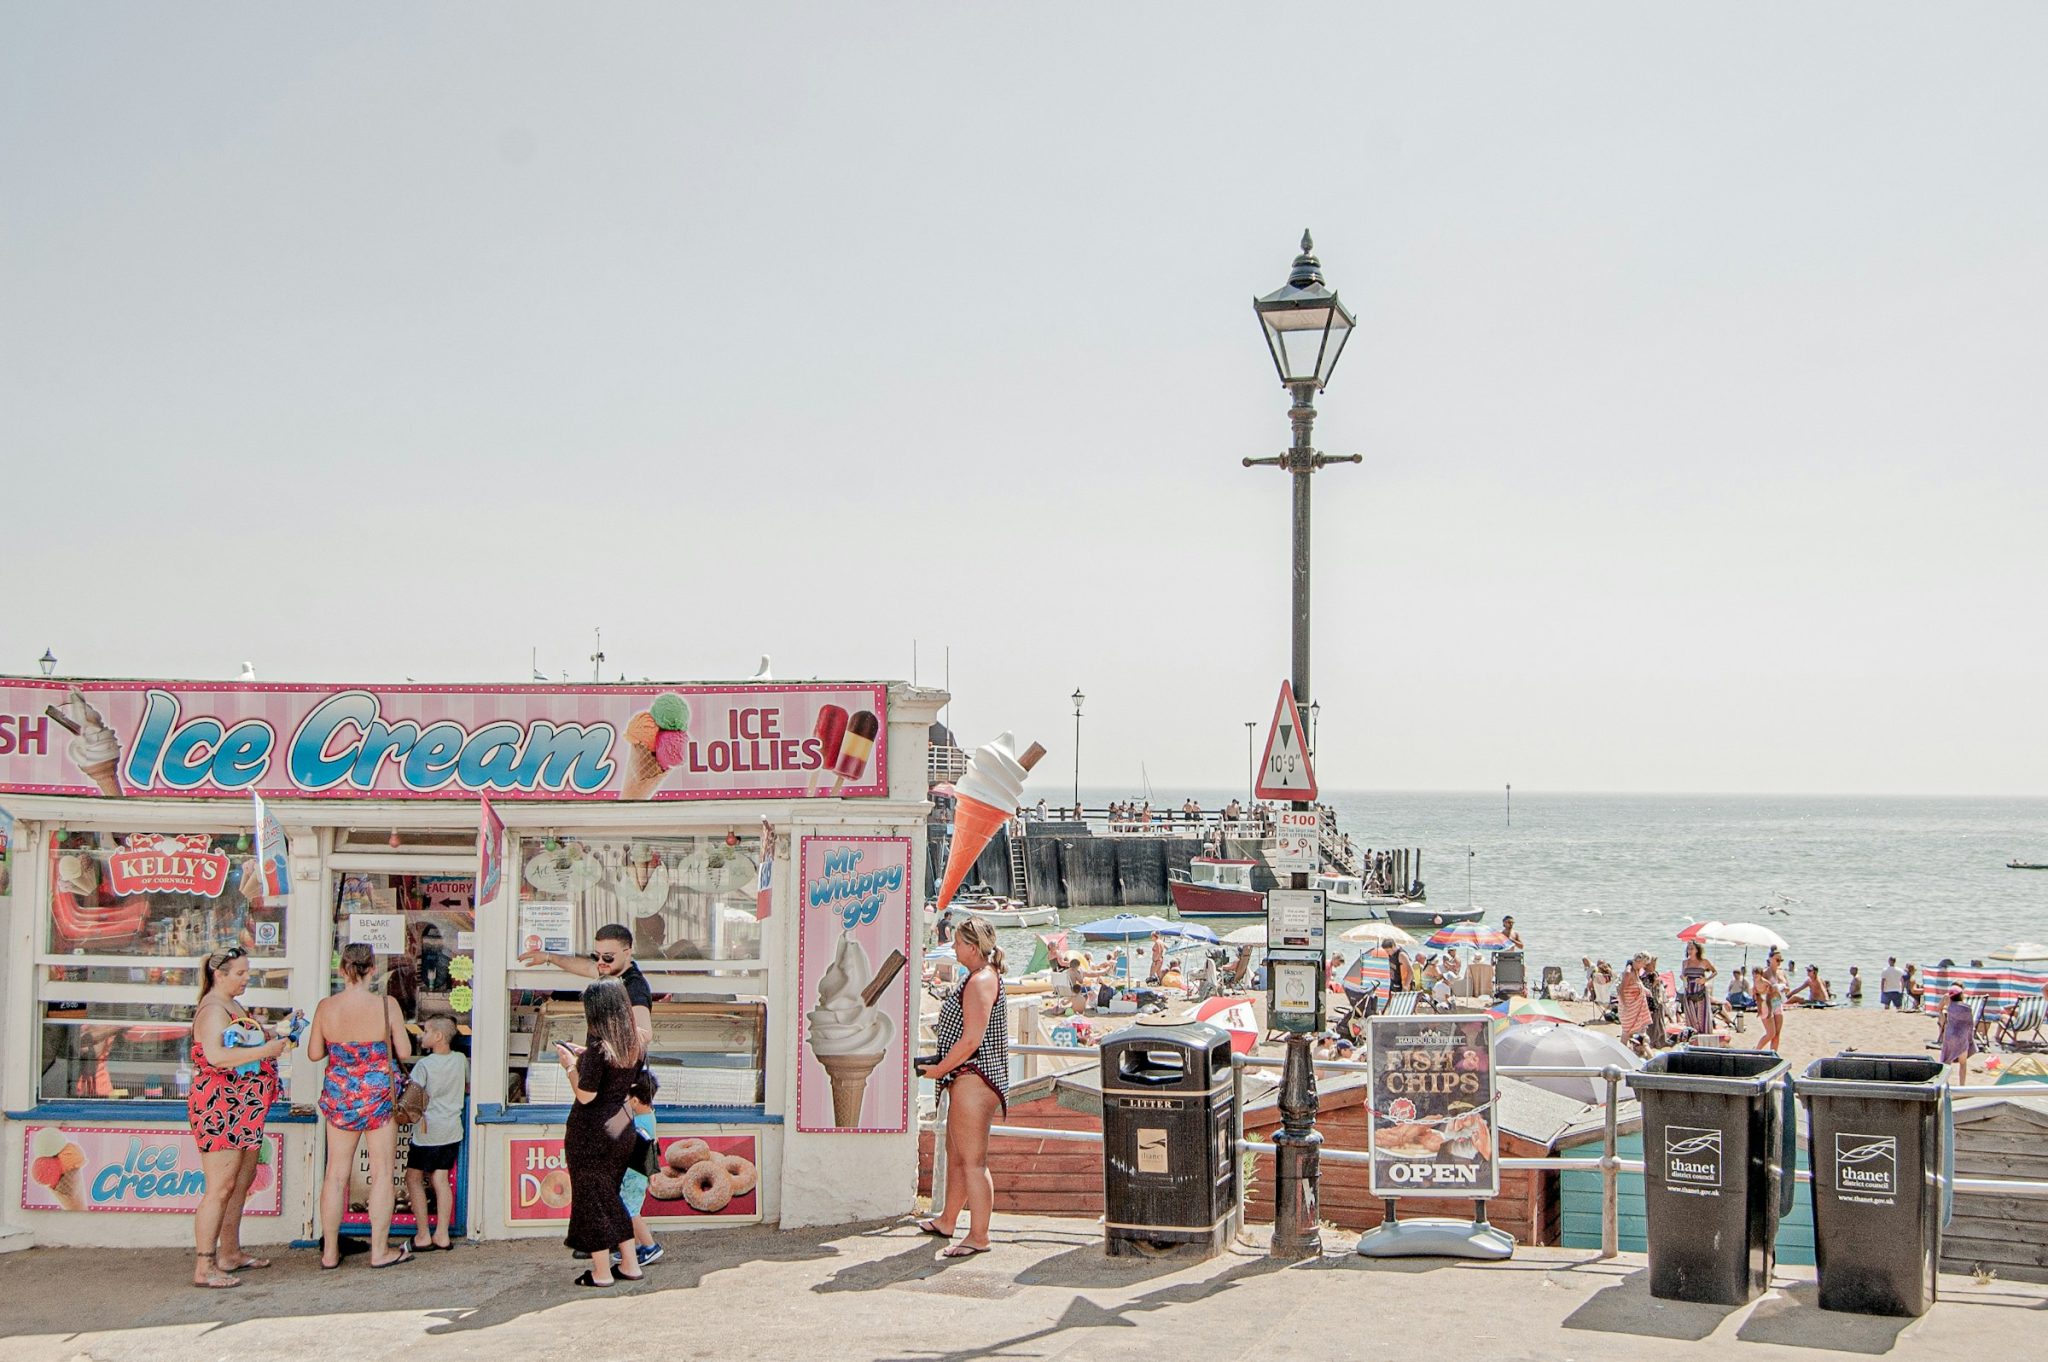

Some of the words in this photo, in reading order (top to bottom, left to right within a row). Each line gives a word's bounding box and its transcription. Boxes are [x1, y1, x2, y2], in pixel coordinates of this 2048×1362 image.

[729, 708, 781, 740] ICE
[124, 689, 277, 791] Ice
[286, 689, 617, 793] Cream
[689, 738, 822, 772] LOLLIES
[1282, 814, 1316, 826] £100
[120, 856, 218, 880] KELLY'S
[824, 846, 864, 879] Mr
[426, 883, 473, 894] FACTORY
[809, 864, 904, 908] Whippy
[360, 919, 391, 927] BEWARE
[1385, 1050, 1455, 1071] FISH
[1462, 1050, 1479, 1071] &
[1386, 1072, 1479, 1094] CHIPS
[1130, 1099, 1172, 1109] LITTER
[122, 1136, 180, 1174] Ice
[1389, 1163, 1480, 1183] OPEN
[1671, 1158, 1716, 1174] thanet
[1671, 1171, 1692, 1179] district
[1842, 1166, 1890, 1182] thanet
[90, 1162, 207, 1203] Cream
[1842, 1179, 1865, 1187] district
